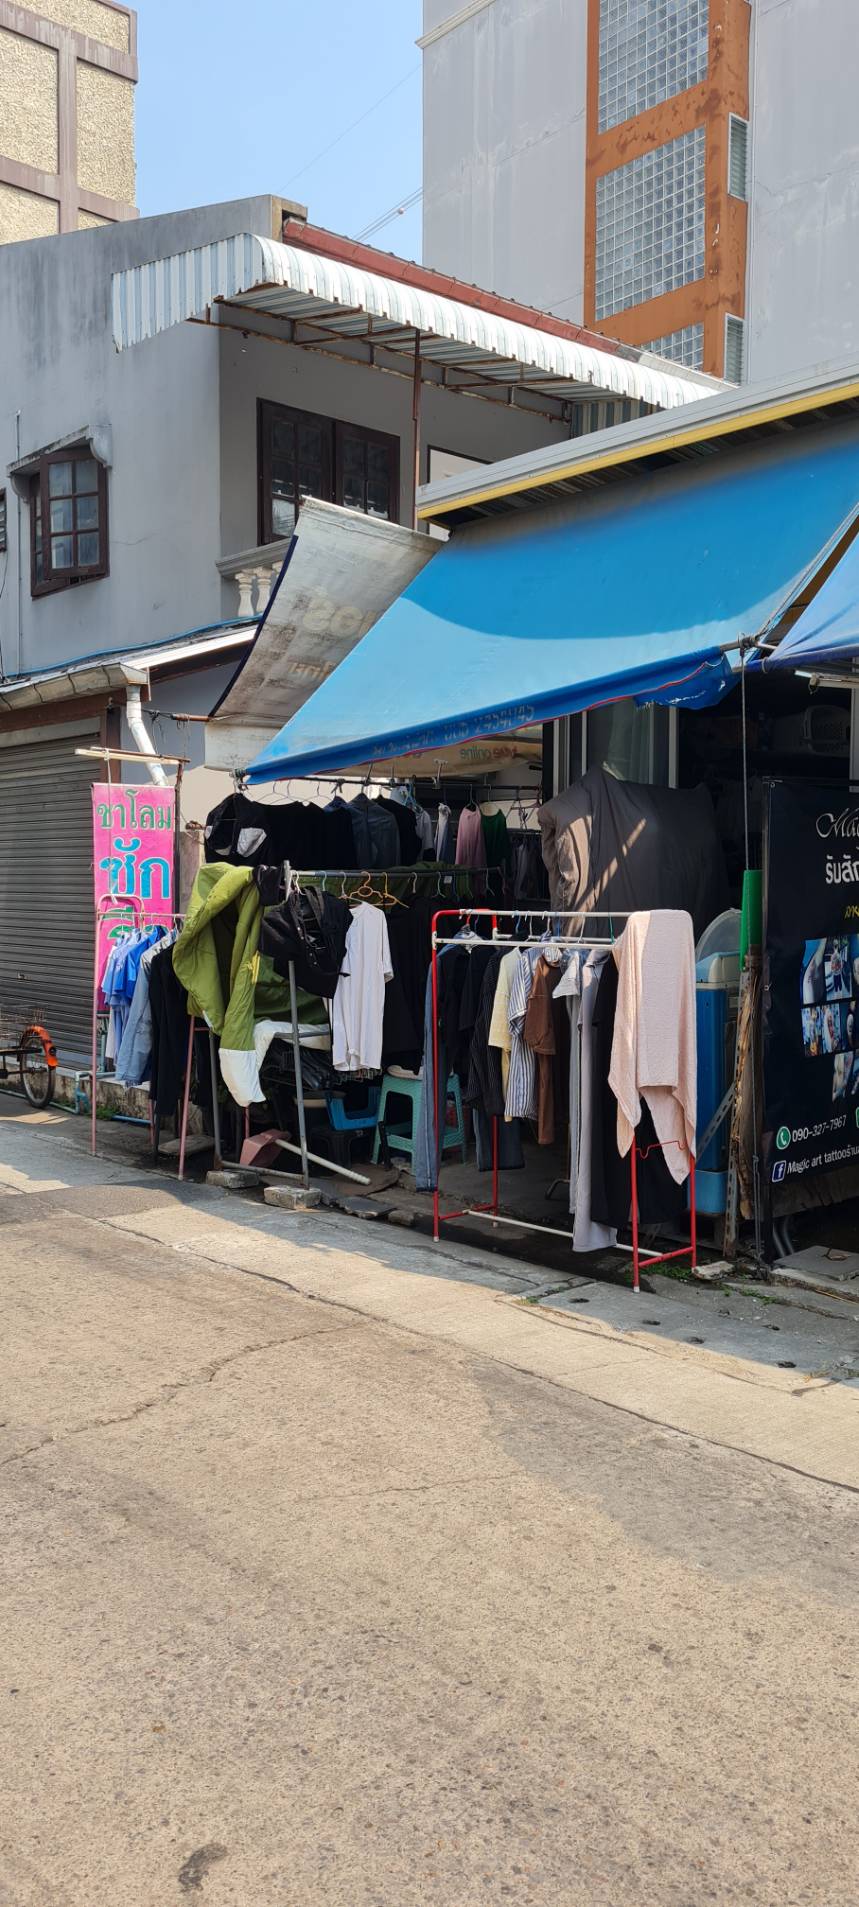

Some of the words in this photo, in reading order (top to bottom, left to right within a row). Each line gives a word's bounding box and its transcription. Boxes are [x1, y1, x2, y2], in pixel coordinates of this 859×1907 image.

[816, 807, 859, 850] Ma
[792, 1115, 847, 1143] 090-327-7967
[787, 1158, 810, 1174] Magic
[811, 1154, 822, 1167] art
